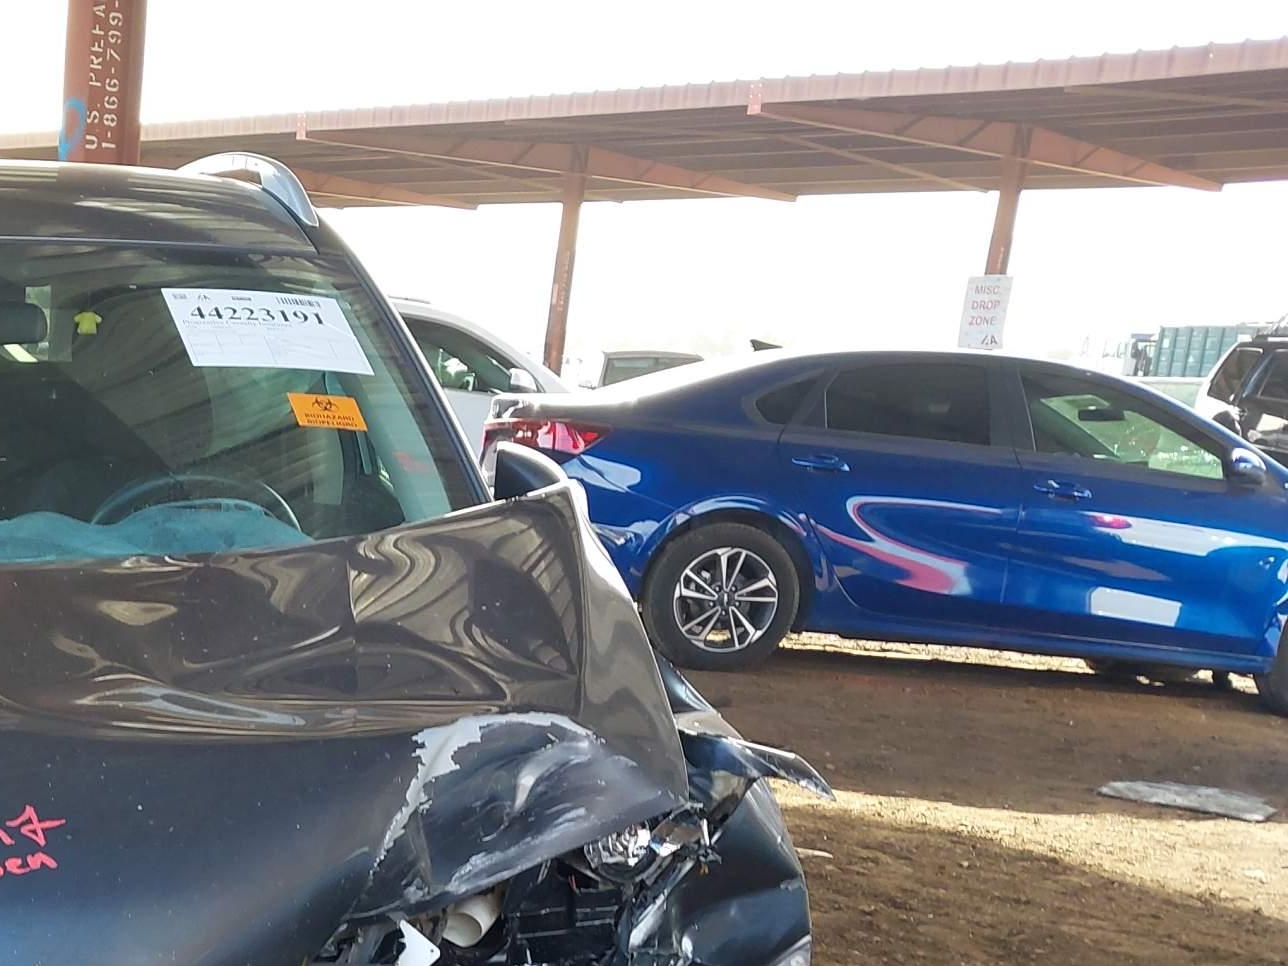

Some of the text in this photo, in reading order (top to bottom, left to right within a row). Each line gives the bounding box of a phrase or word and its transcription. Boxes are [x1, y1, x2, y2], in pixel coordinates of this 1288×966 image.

[972, 300, 1000, 310] DROP
[191, 305, 324, 326] 44223191
[968, 316, 997, 326] ZONE
